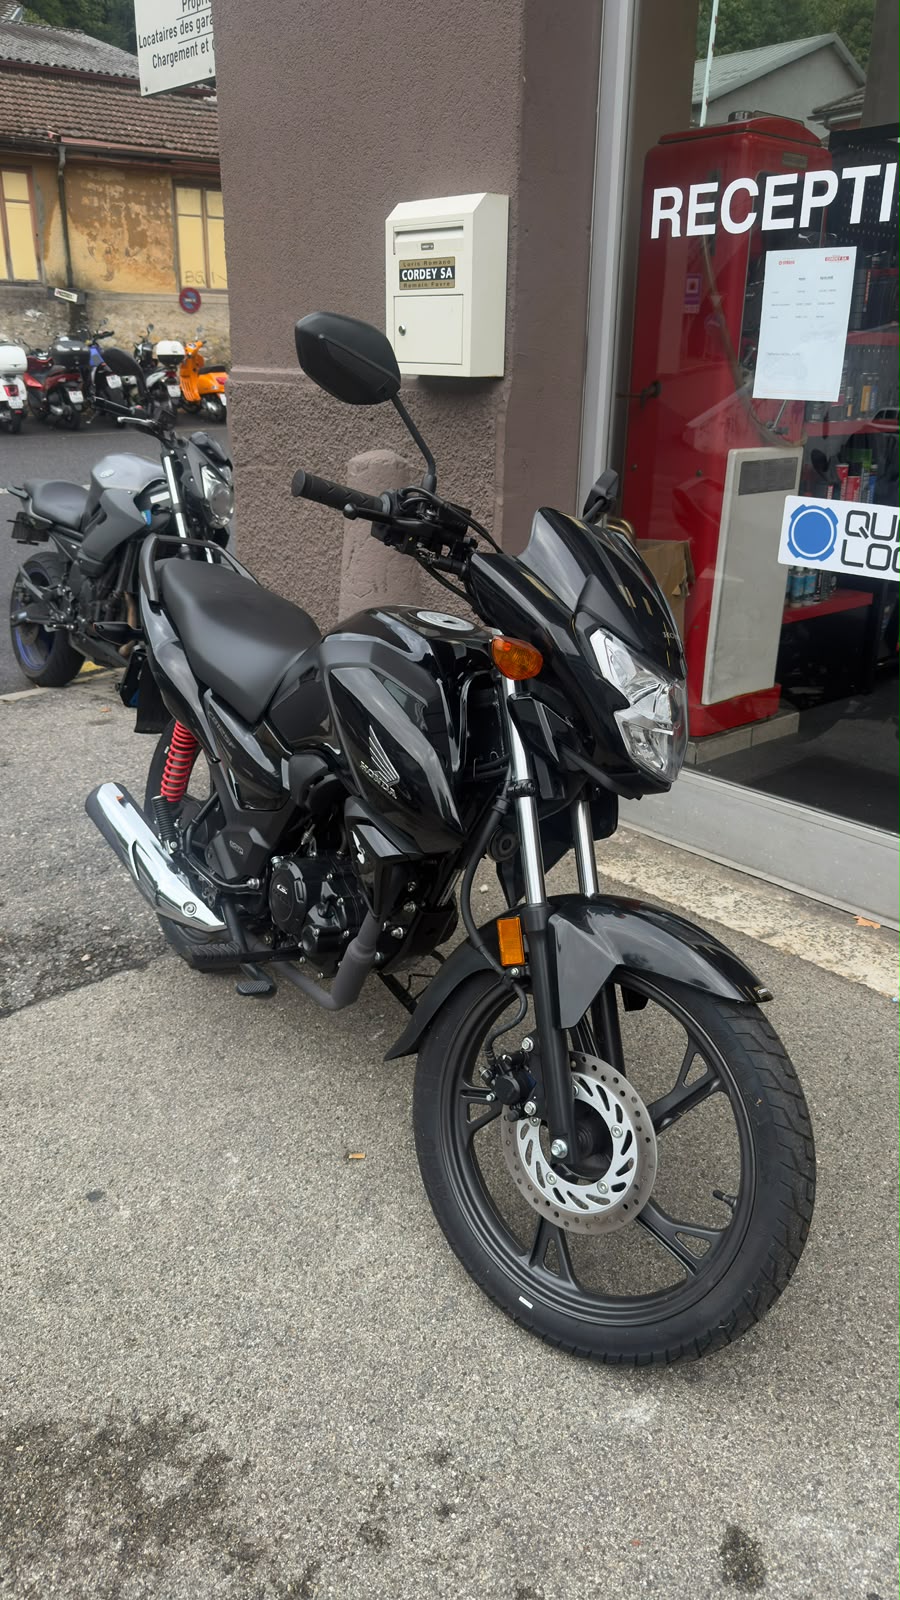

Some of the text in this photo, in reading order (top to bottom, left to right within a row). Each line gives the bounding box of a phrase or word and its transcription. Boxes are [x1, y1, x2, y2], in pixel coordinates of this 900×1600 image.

[138, 25, 178, 49] Locataires
[179, 19, 194, 36] des
[152, 43, 198, 69] Chargement
[200, 37, 209, 54] et
[650, 162, 898, 240] RECEPTI
[401, 267, 453, 281] CORDEY SA
[360, 760, 398, 800] HONDA
